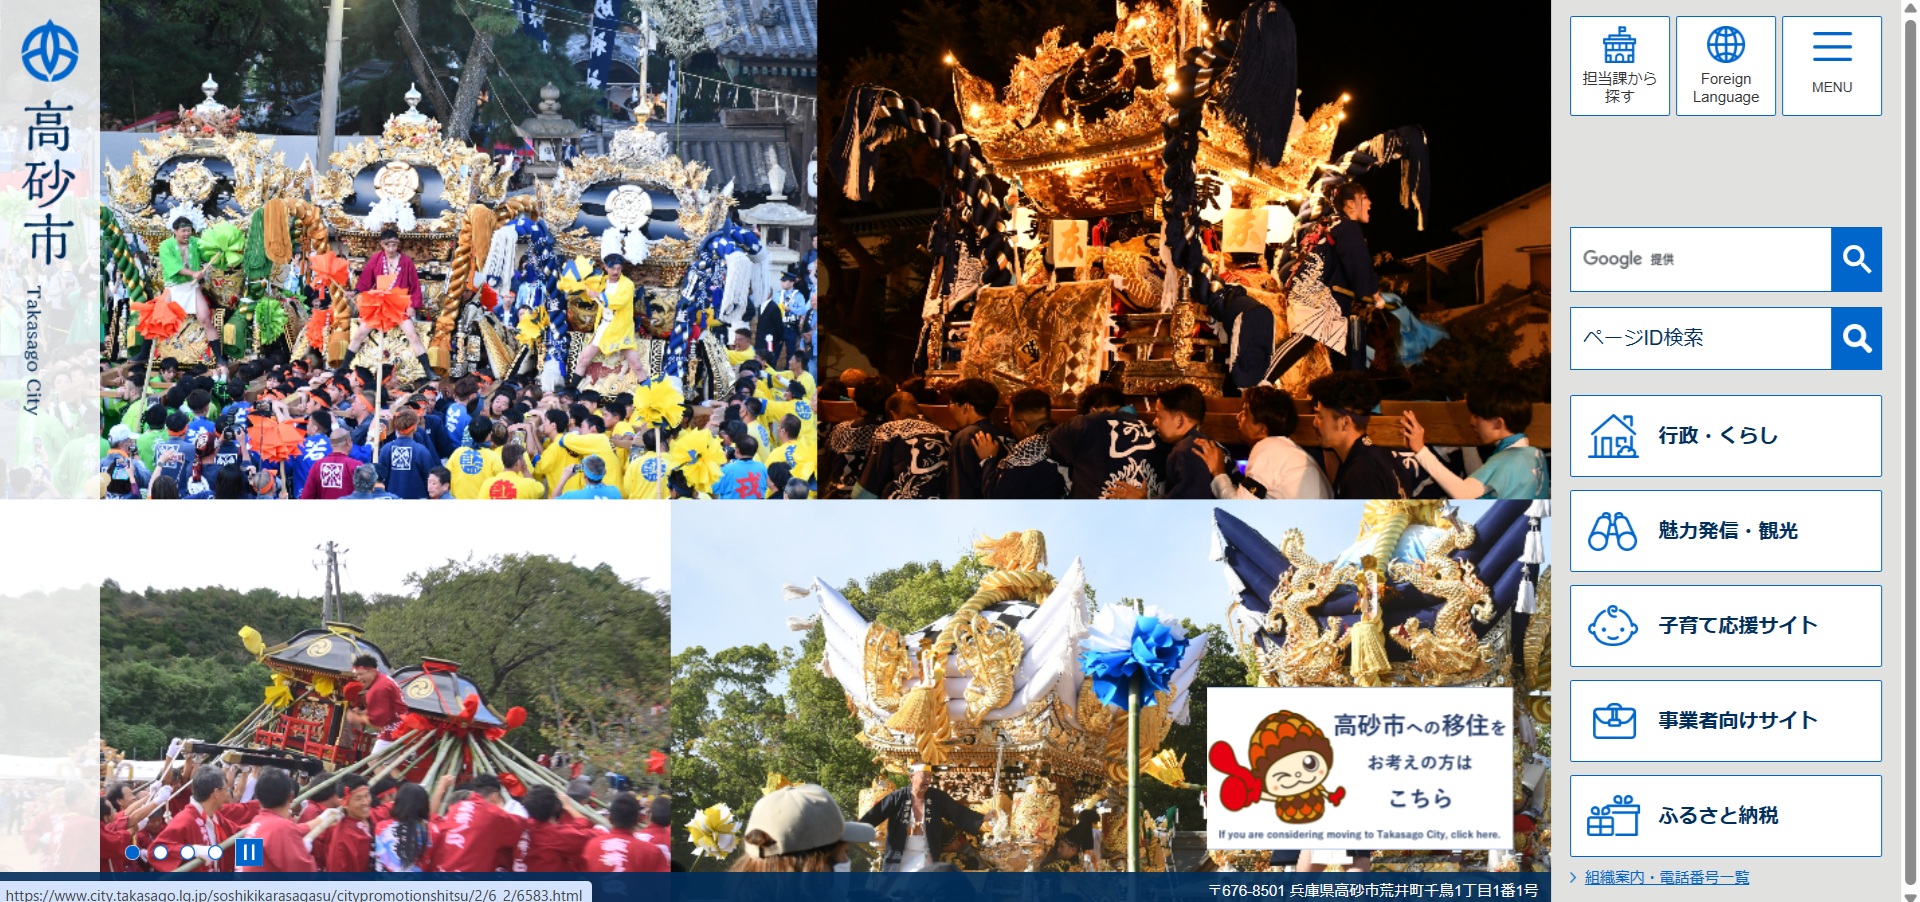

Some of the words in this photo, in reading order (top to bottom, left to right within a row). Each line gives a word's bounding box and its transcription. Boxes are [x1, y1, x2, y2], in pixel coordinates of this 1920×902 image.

[1582, 70, 1657, 87] 担当課から
[1700, 72, 1752, 88] Foreign
[1812, 81, 1853, 93] MENU
[1604, 89, 1635, 104] 探す
[1693, 91, 1760, 106] Language
[22, 99, 76, 266] 高砂市
[1582, 250, 1643, 269] Google
[1650, 252, 1675, 267] 提供
[24, 285, 42, 372] Takasago
[1583, 327, 1704, 348] ページID検索
[24, 379, 42, 416] City
[1659, 425, 1779, 445] 行政・くらし
[1659, 520, 1799, 541] 魅力発信・観光
[1659, 615, 1818, 635] 子育て応援サイト
[1333, 713, 1507, 738] 高砂市への移住を
[1659, 710, 1818, 730] 事業者向けサイト
[1367, 754, 1473, 772] お考えの方は
[1389, 788, 1452, 810] こちら
[1658, 804, 1780, 825] ふるさと納税
[1218, 829, 1226, 839] If
[1227, 829, 1246, 841] you
[1248, 829, 1265, 839] are
[1266, 829, 1325, 841] considering
[1326, 829, 1362, 841] moving
[1363, 829, 1375, 839] to
[1376, 829, 1425, 841] Takasago
[1427, 829, 1449, 841] City,
[1450, 829, 1474, 839] click
[1475, 829, 1502, 839] here.
[1584, 869, 1751, 887] 組織案内・電話番号一覧
[5, 889, 583, 902] https://www.city.takasago.lg.jp/soshikikarasagasu/citypromotionshitsu/2/62/6583.html
[1209, 883, 1284, 898] 〒676-8501
[1289, 882, 1539, 898] 兵庫県高砂市荒井町千鳥1丁目1番1号
